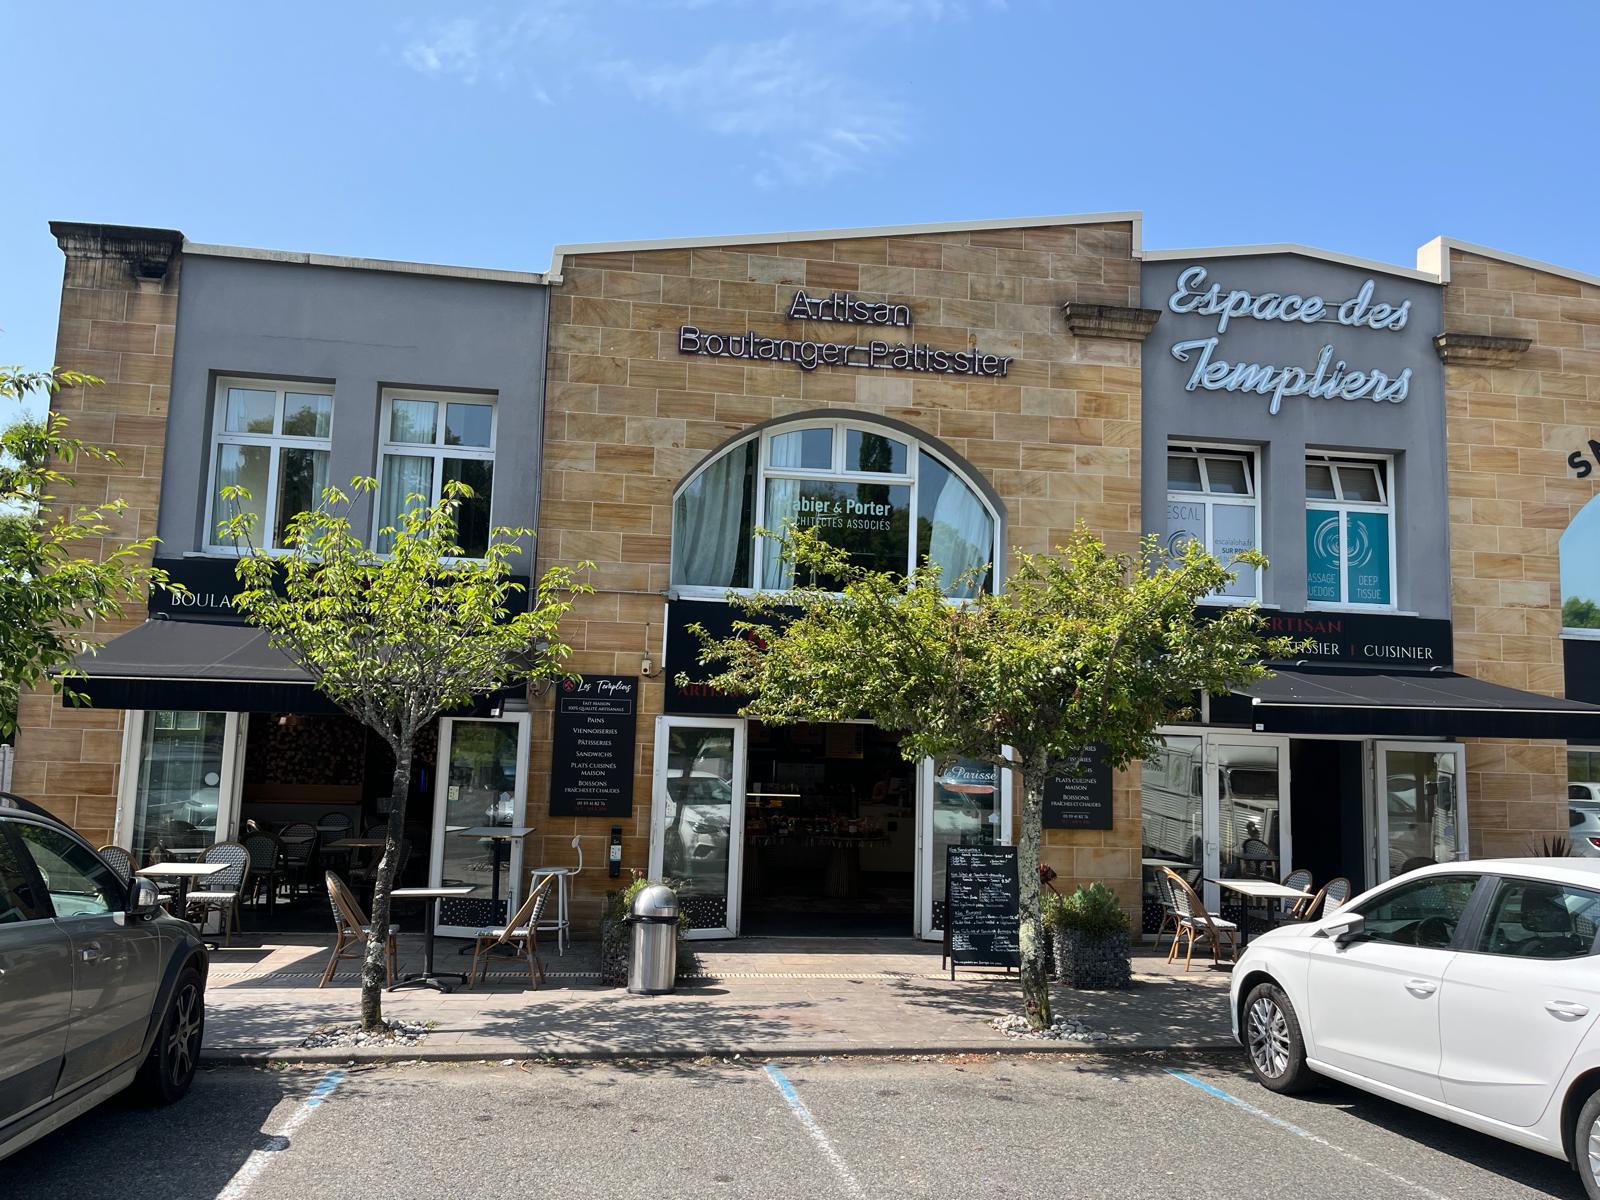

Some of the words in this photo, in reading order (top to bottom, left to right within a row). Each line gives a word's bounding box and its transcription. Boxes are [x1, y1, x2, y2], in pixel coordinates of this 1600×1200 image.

[788, 289, 912, 326] Artisan
[1168, 265, 1327, 334] Espace
[1337, 279, 1412, 331] des
[678, 325, 859, 371] Boulanger
[868, 340, 1014, 377] Pâtissier
[1170, 337, 1413, 415] Templiers
[792, 496, 831, 513] abier
[833, 502, 842, 513] &
[846, 498, 891, 516] Porter
[846, 518, 891, 531] ASSOCIÉS
[1307, 573, 1336, 584] ASSAGE
[1358, 575, 1378, 586] DEEP
[1307, 586, 1335, 597] UEDOIS
[1356, 588, 1382, 600] TISSUE
[1270, 616, 1344, 633] RTISAN
[1363, 644, 1434, 659] CUISINIER
[577, 679, 592, 692] Les
[596, 679, 632, 696] Templiers
[573, 727, 618, 735] VIENNOISERIES
